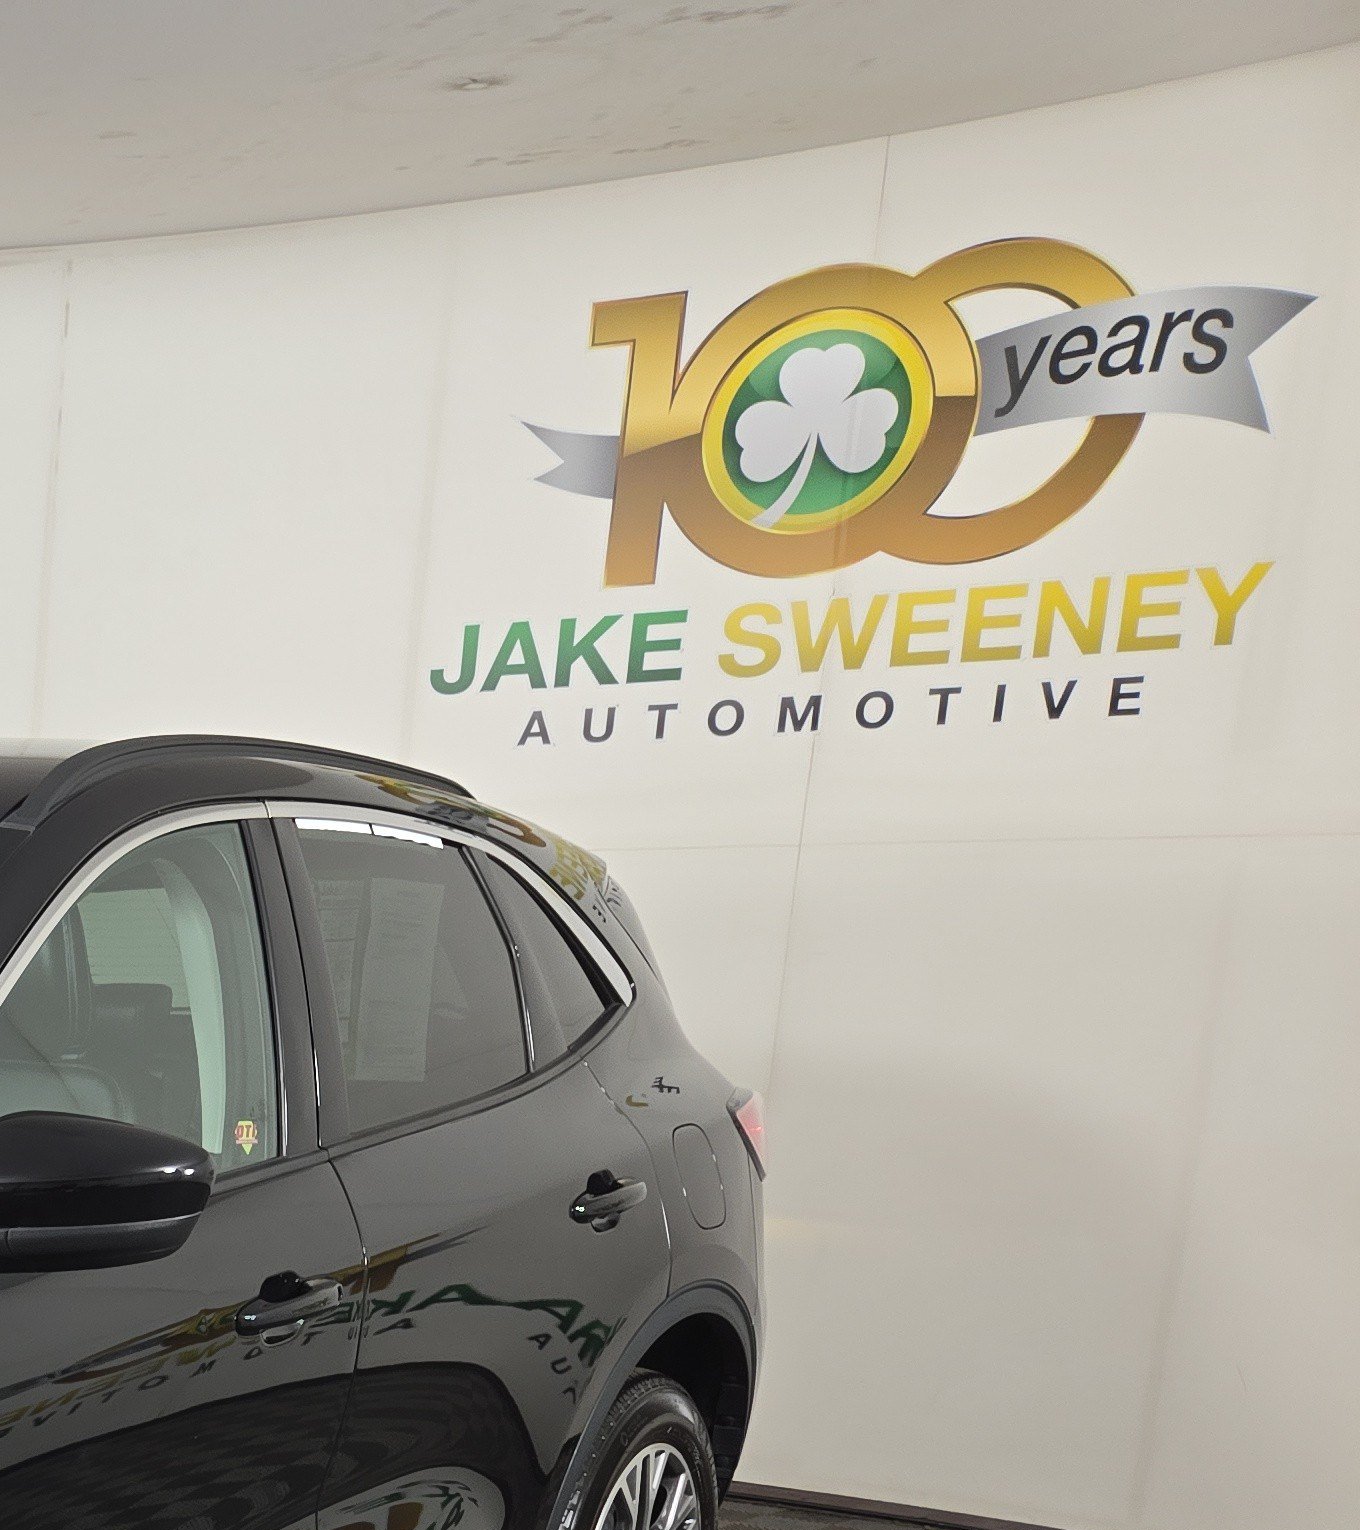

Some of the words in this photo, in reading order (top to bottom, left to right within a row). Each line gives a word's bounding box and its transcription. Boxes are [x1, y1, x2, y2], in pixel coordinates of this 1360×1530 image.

[589, 236, 1146, 588] 100
[994, 301, 1234, 418] years
[429, 609, 689, 696] JAKE
[717, 561, 1276, 679] SWEENEY
[518, 674, 1147, 748] AUTOMOTIVE
